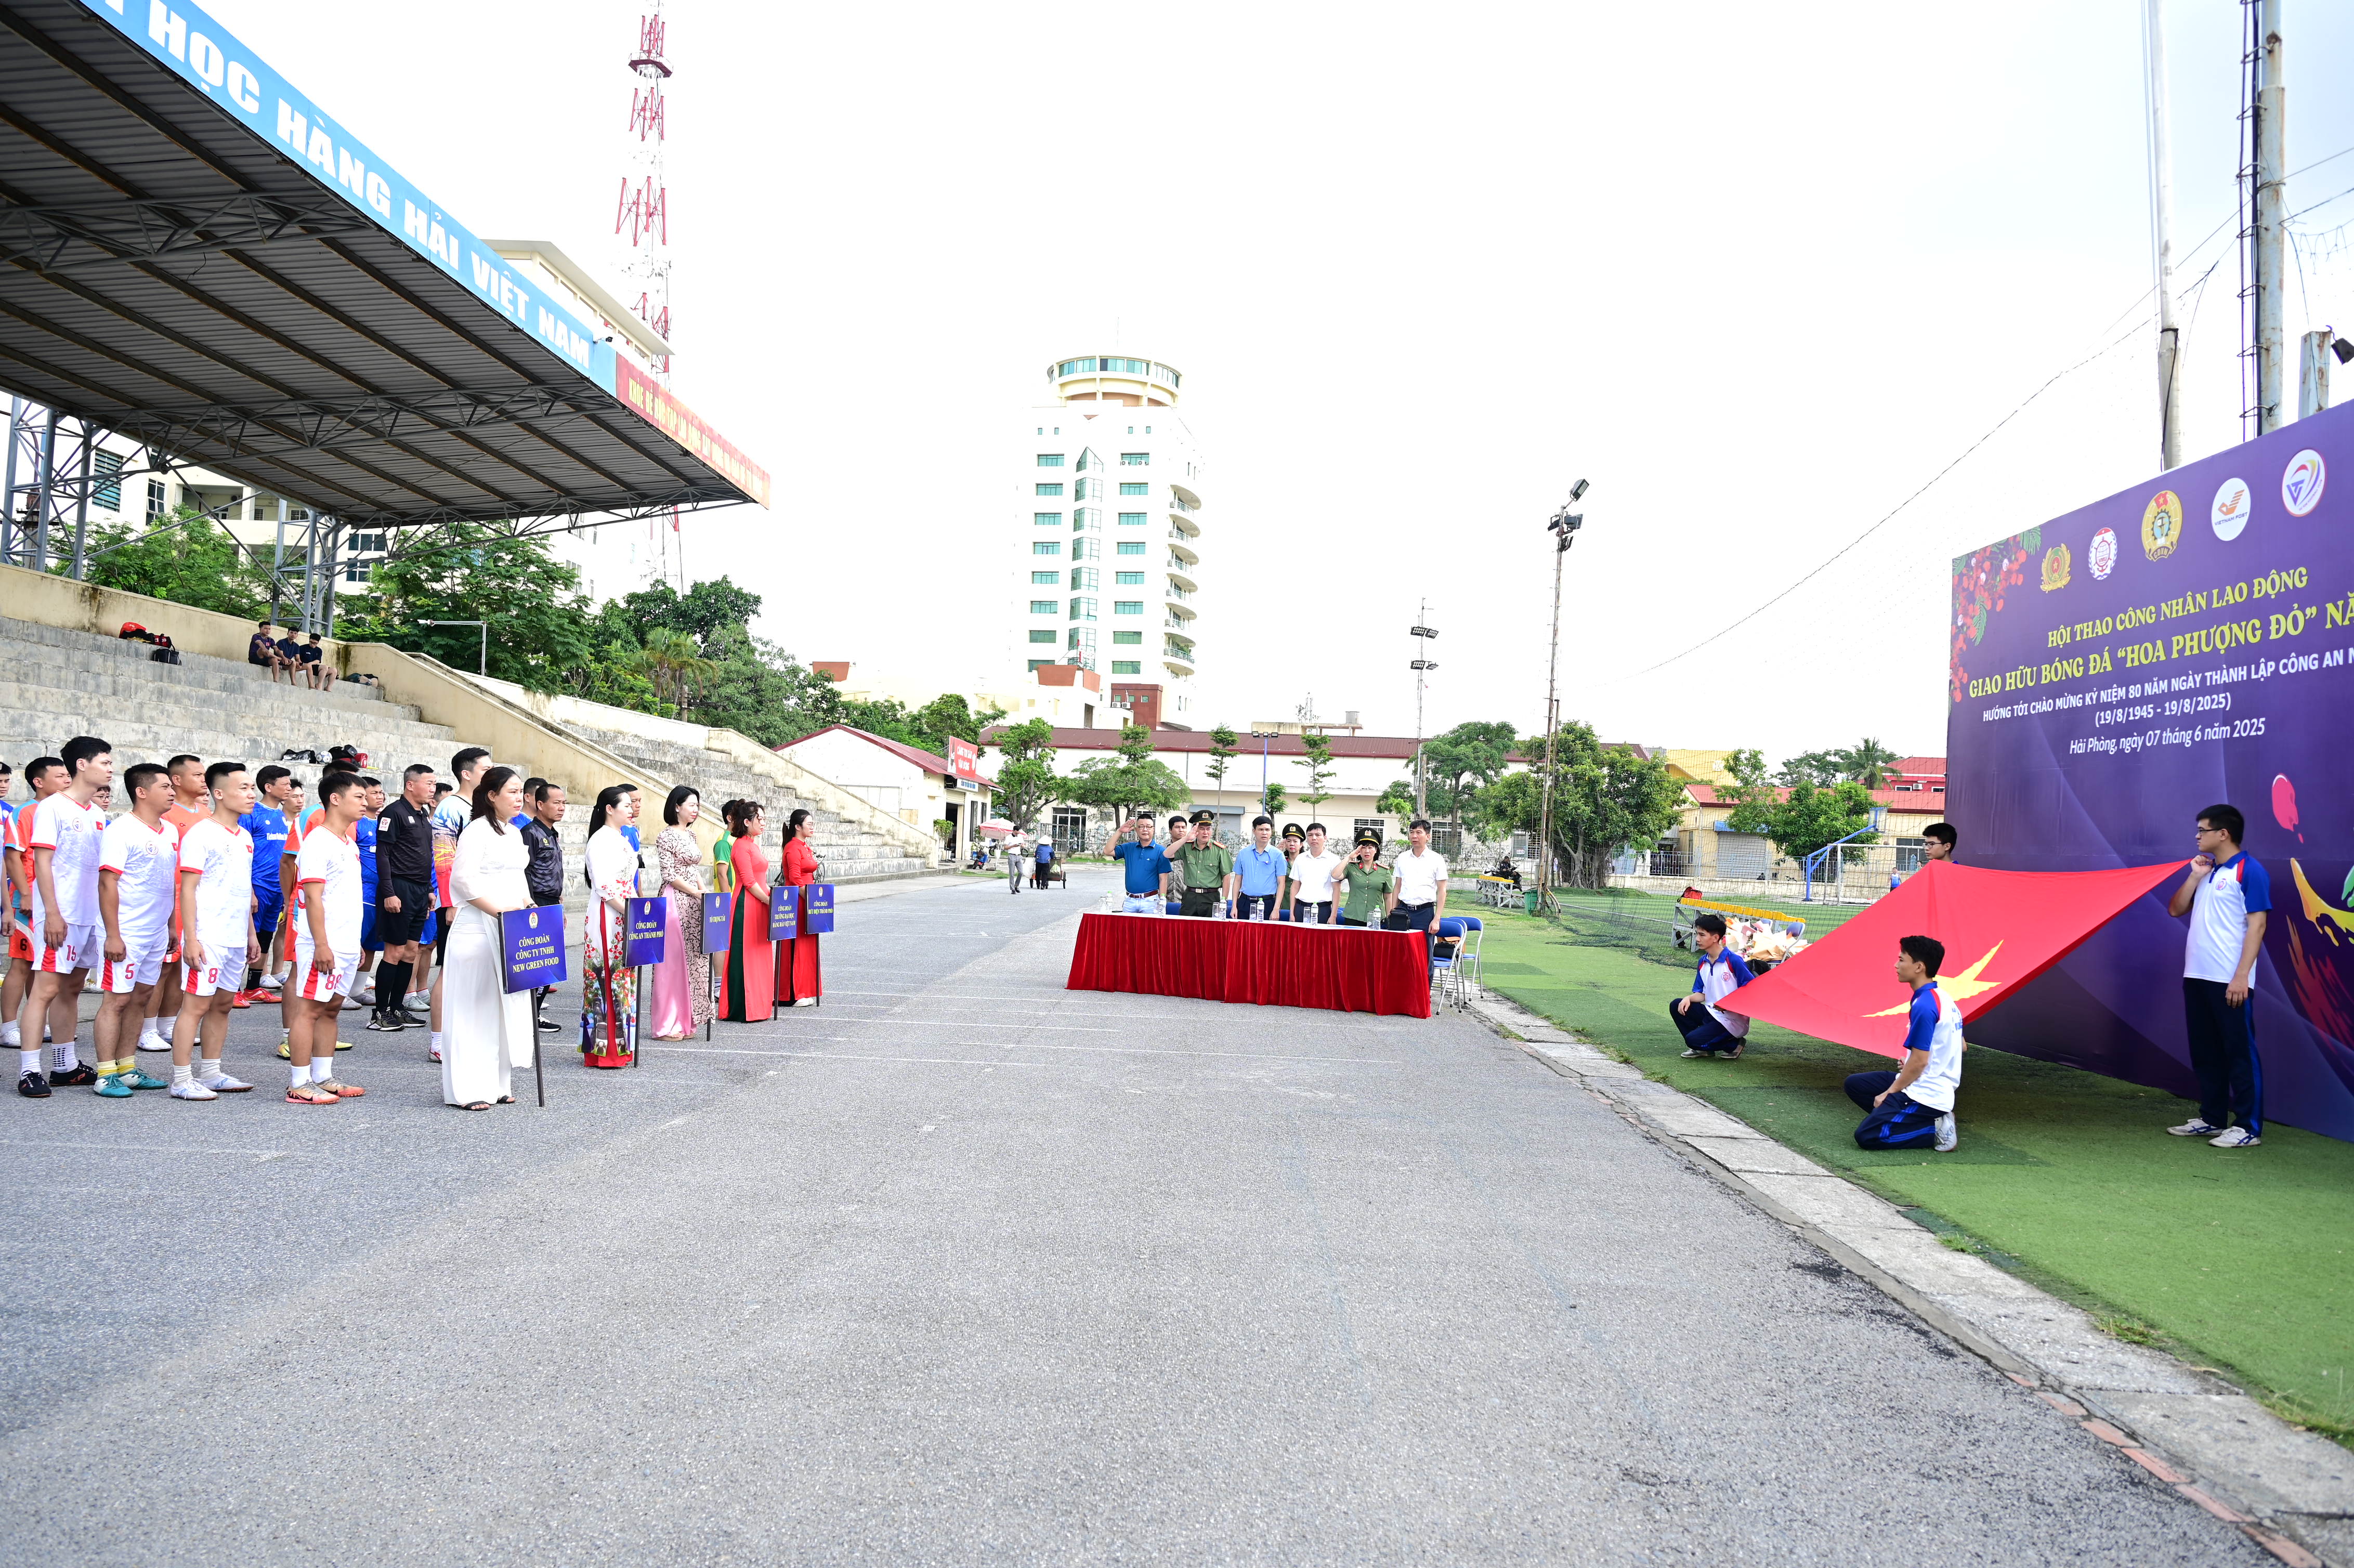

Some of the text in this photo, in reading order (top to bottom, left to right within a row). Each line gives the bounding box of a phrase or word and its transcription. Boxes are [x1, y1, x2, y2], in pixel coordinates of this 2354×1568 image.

[148, 0, 590, 369] HỌC HÀNG HẢI VIỆT NAM
[2047, 567, 2308, 648] HỘI THAO CÔNG NHÂN LAO ĐỘNG
[1969, 674, 2002, 698] GIAO
[2005, 665, 2037, 691] HỮU
[2041, 657, 2084, 684] BÓNG
[2088, 646, 2112, 675] ĐÁ
[2171, 619, 2262, 659] PHƯỢNG
[1983, 704, 2011, 722] HƯỚNG
[2013, 700, 2028, 716] TỚI
[2030, 696, 2054, 714] CHÀO
[2055, 692, 2083, 710] MỪNG
[2085, 687, 2098, 705] KỶ
[2100, 684, 2126, 704] NIỆM
[2128, 684, 2141, 699] 80
[2144, 677, 2168, 695] NĂM
[2171, 671, 2202, 692] NGÀY
[2205, 664, 2247, 686] THÀNH
[2251, 658, 2275, 682] LẬP
[2279, 652, 2319, 674] CÔNG
[2322, 648, 2344, 668] AN
[2095, 704, 2154, 728] (19/8/1945
[2164, 692, 2231, 716] 19/8/2025)
[2070, 717, 2266, 755] Hải Phòng, ngày 07 tháng 6 năm 2025
[636, 920, 657, 930] CÔNG ĐOÀN
[519, 933, 550, 947] CÔNG ĐOÀN
[629, 931, 638, 940] CÔNG
[644, 930, 656, 939] THÀNH
[19, 938, 27, 951] 6
[516, 946, 554, 960] CÔNG TY TNHH
[125, 963, 135, 979] 5
[513, 957, 559, 973] NEW GREEN FOOD
[208, 968, 218, 984] 8
